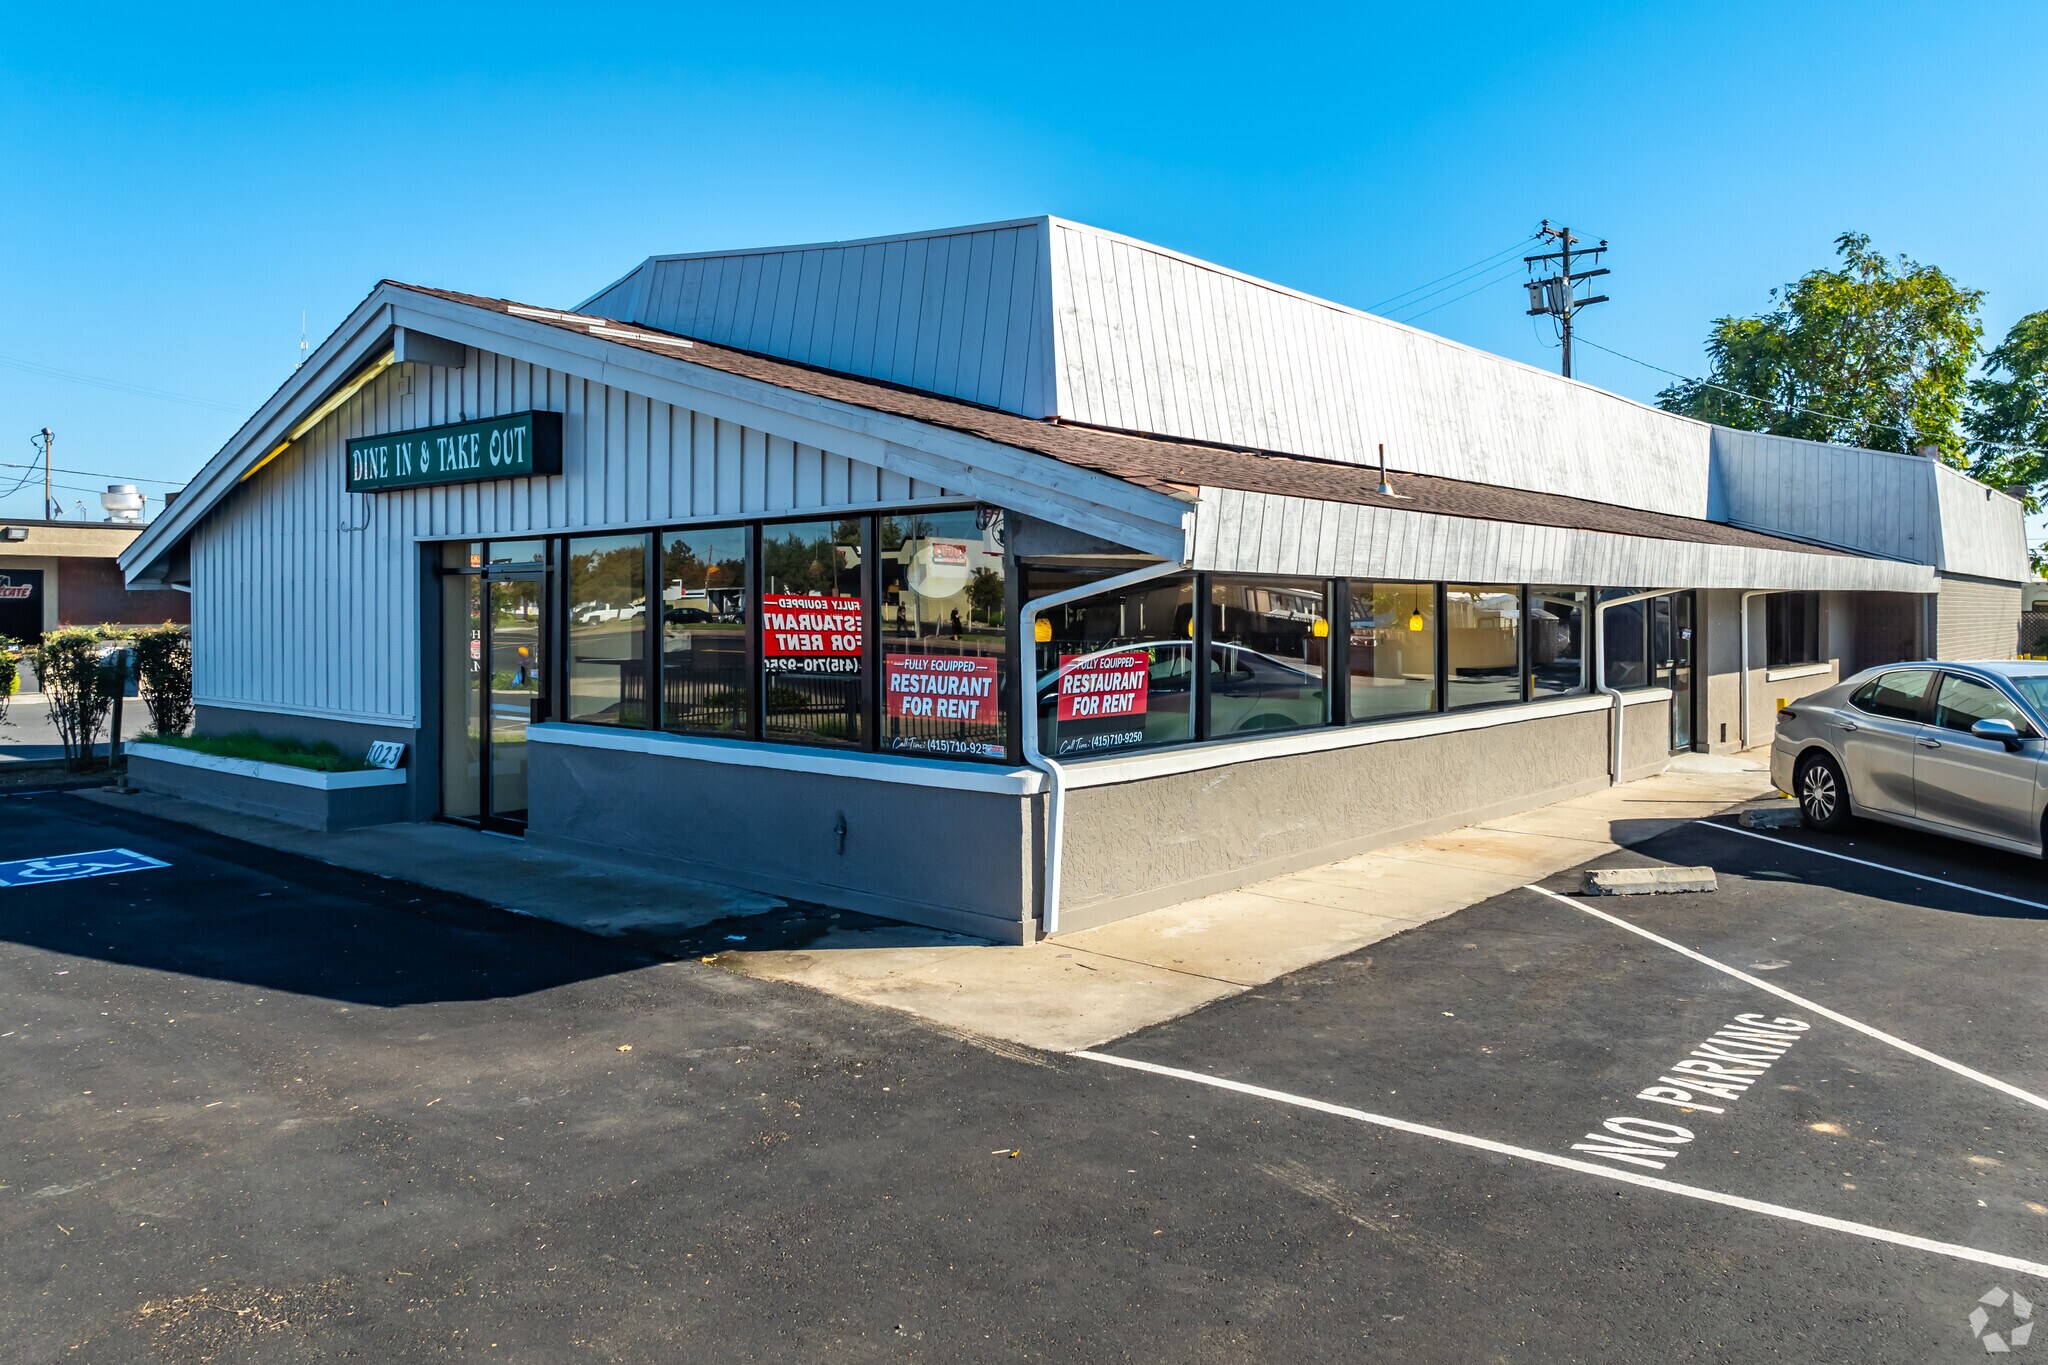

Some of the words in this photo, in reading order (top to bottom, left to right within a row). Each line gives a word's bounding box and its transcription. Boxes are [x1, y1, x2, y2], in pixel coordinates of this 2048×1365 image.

[353, 445, 388, 481] DINE
[396, 442, 412, 476] IN
[420, 441, 430, 473] &
[437, 433, 480, 472] TAKE
[489, 426, 526, 467] OUT
[0, 587, 30, 597] ECATE
[904, 658, 929, 670] FULLY
[930, 660, 976, 672] EQUIPPED
[1100, 657, 1134, 669] EQUIPPED
[890, 673, 993, 697] RESTAURANT
[1062, 671, 1145, 694] RESTAURANT
[902, 696, 933, 717] FOR
[936, 698, 980, 720] RENT
[1072, 695, 1100, 717] FOR
[1101, 693, 1135, 714] RENT
[368, 744, 401, 764] 1023
[892, 736, 908, 749] Call
[927, 739, 987, 754] (415)710-925
[1060, 738, 1075, 754] Call
[1091, 731, 1142, 749] (415)710-9250
[1571, 1117, 1695, 1169] NO
[1636, 1013, 1811, 1113] PARKING
